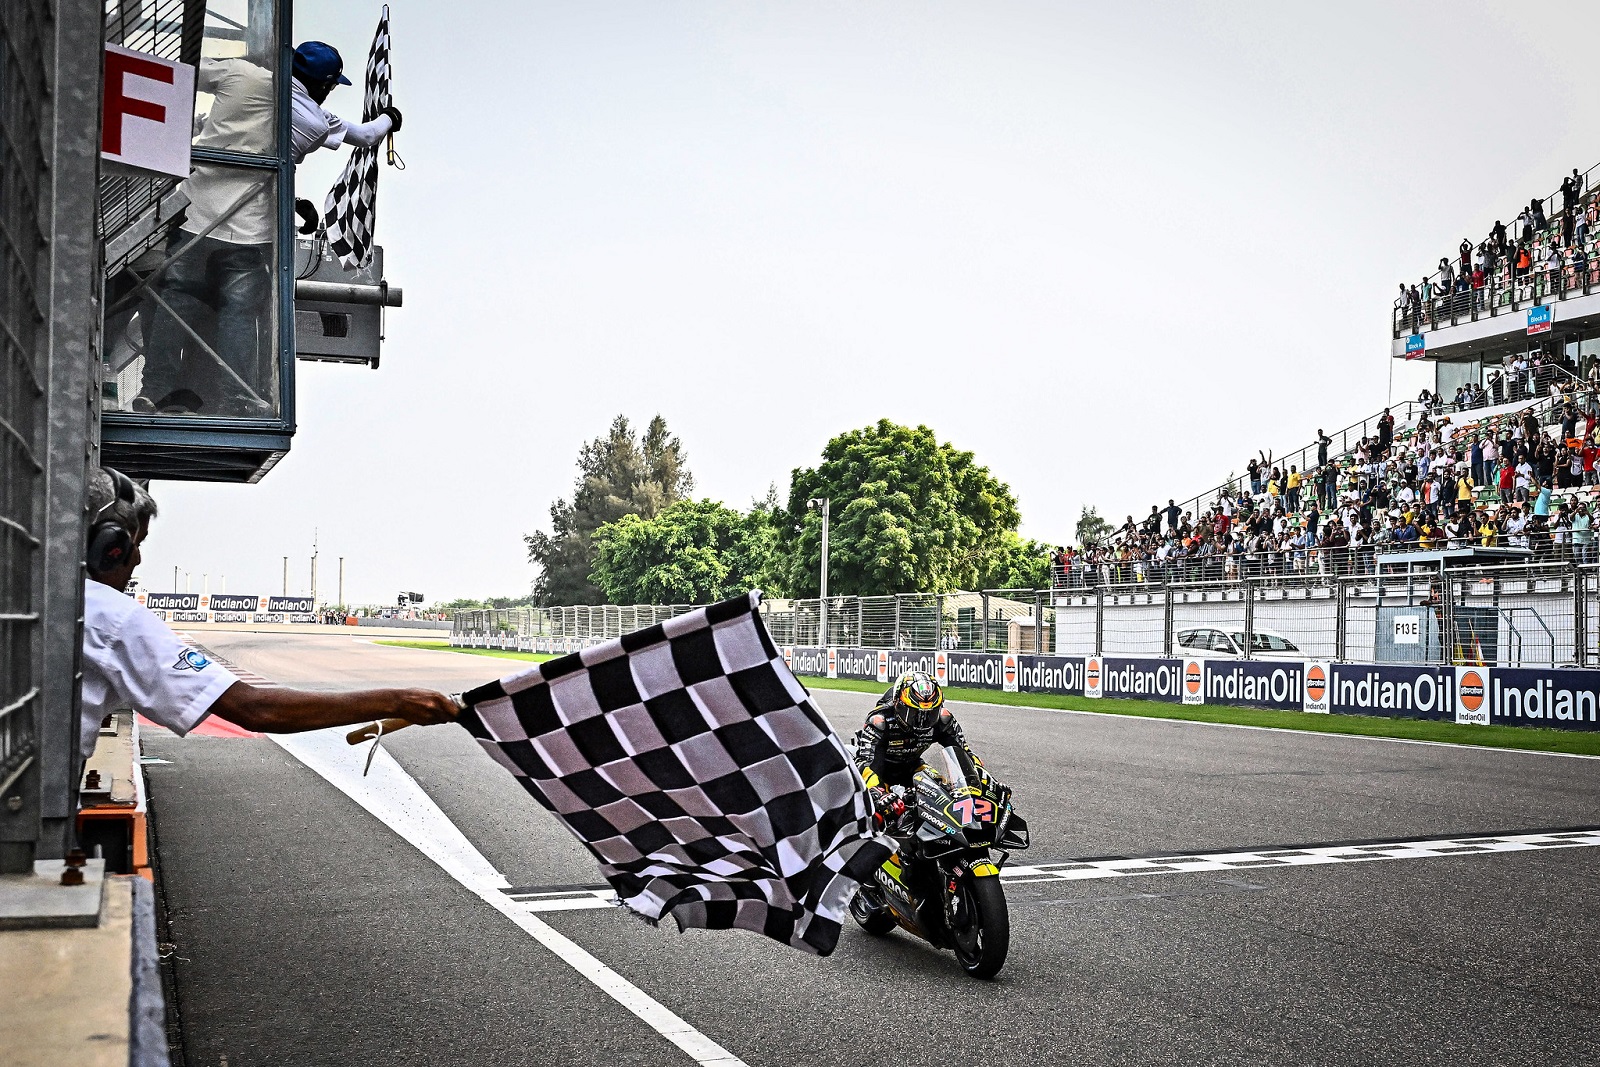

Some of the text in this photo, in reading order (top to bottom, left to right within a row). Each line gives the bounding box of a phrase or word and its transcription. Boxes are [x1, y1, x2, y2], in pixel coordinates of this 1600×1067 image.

[102, 49, 174, 156] F
[148, 596, 197, 608] IndianOil
[211, 597, 257, 610] IndianOil
[269, 599, 313, 611] IndianOil
[174, 612, 207, 621] IndianOil
[215, 613, 246, 622] IndianOil
[1395, 623, 1418, 635] F13 E
[793, 651, 827, 673] IndianOil
[837, 653, 877, 676] IndianOil
[948, 658, 1002, 685] IndianOil
[1018, 661, 1084, 691] IndianOil
[1104, 664, 1181, 696] IndianOil
[1206, 667, 1301, 703] IndianOil
[1333, 671, 1452, 713] IndianOil
[1494, 677, 1600, 722] Indian
[1305, 702, 1327, 711] IndianOil
[1458, 712, 1486, 722] IndianOil
[921, 811, 956, 835] mooneygo
[952, 797, 992, 826] 72
